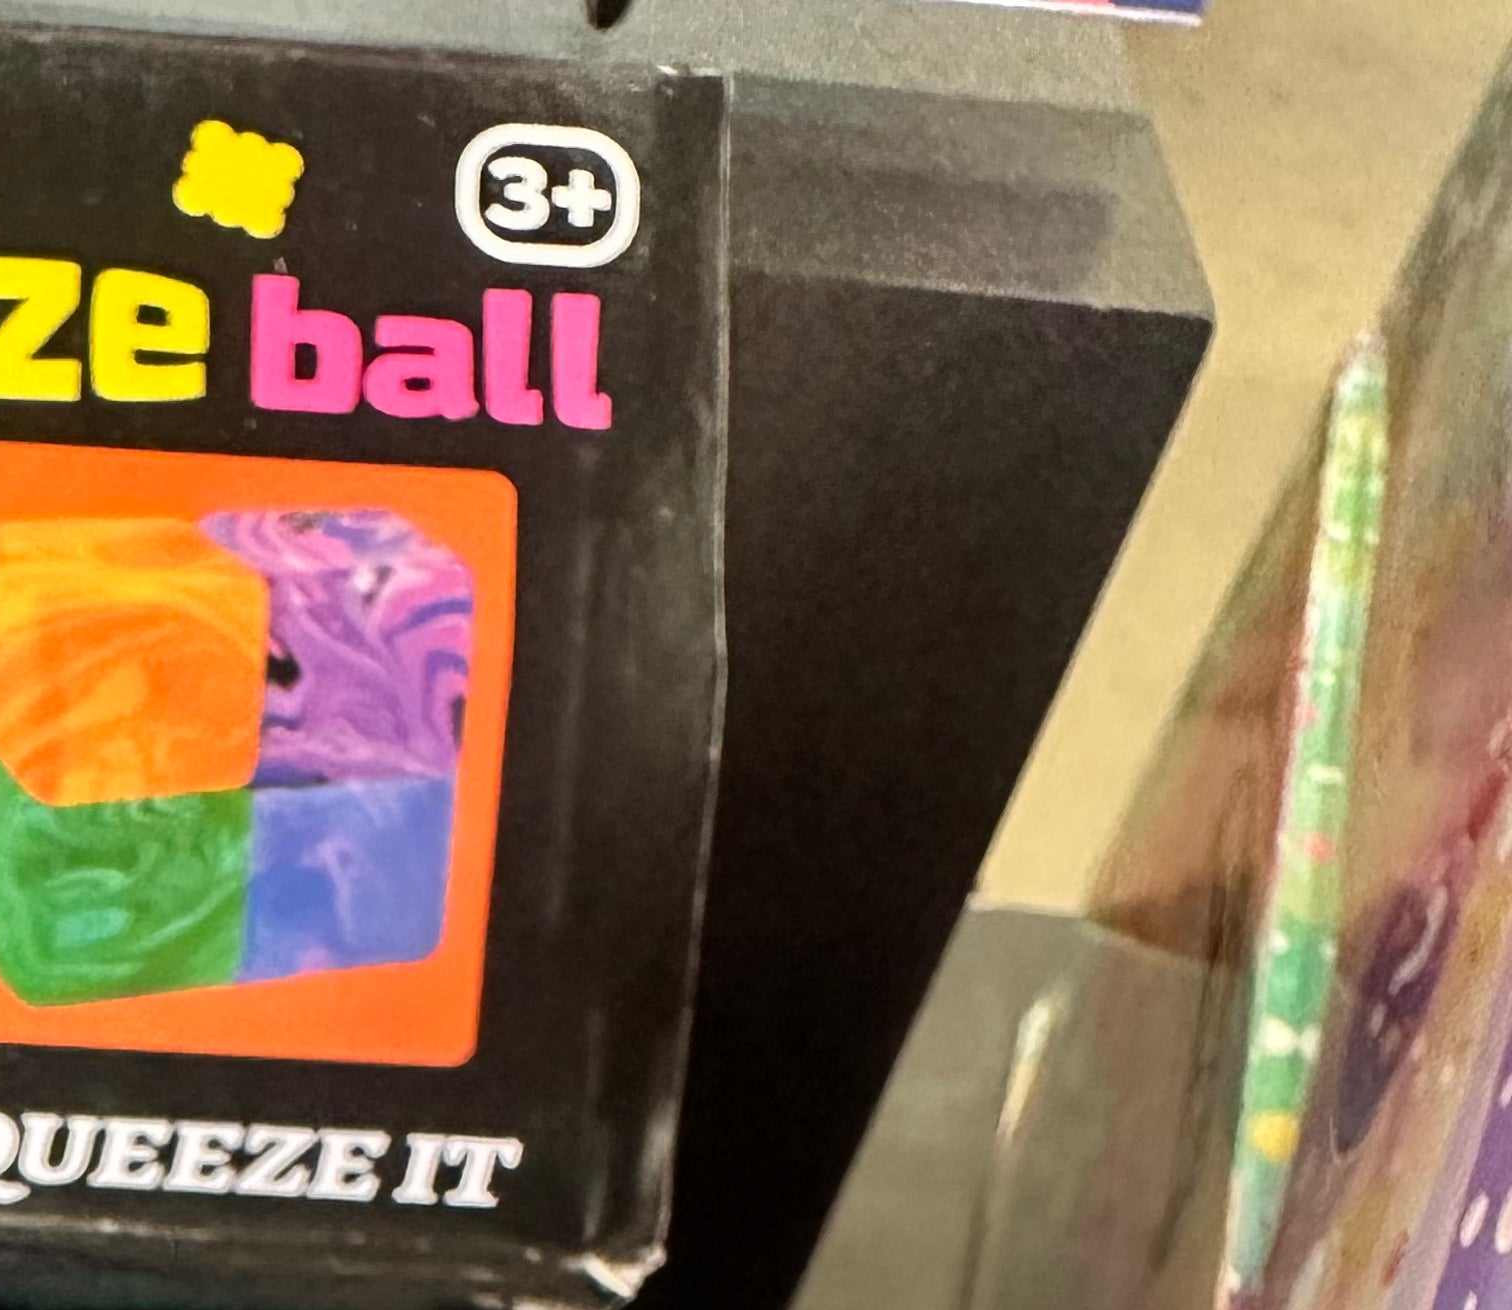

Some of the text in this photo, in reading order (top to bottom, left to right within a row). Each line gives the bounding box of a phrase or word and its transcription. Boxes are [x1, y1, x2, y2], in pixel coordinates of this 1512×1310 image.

[484, 156, 612, 231] 3+
[250, 273, 613, 430] ball
[391, 1132, 524, 1208] IT
